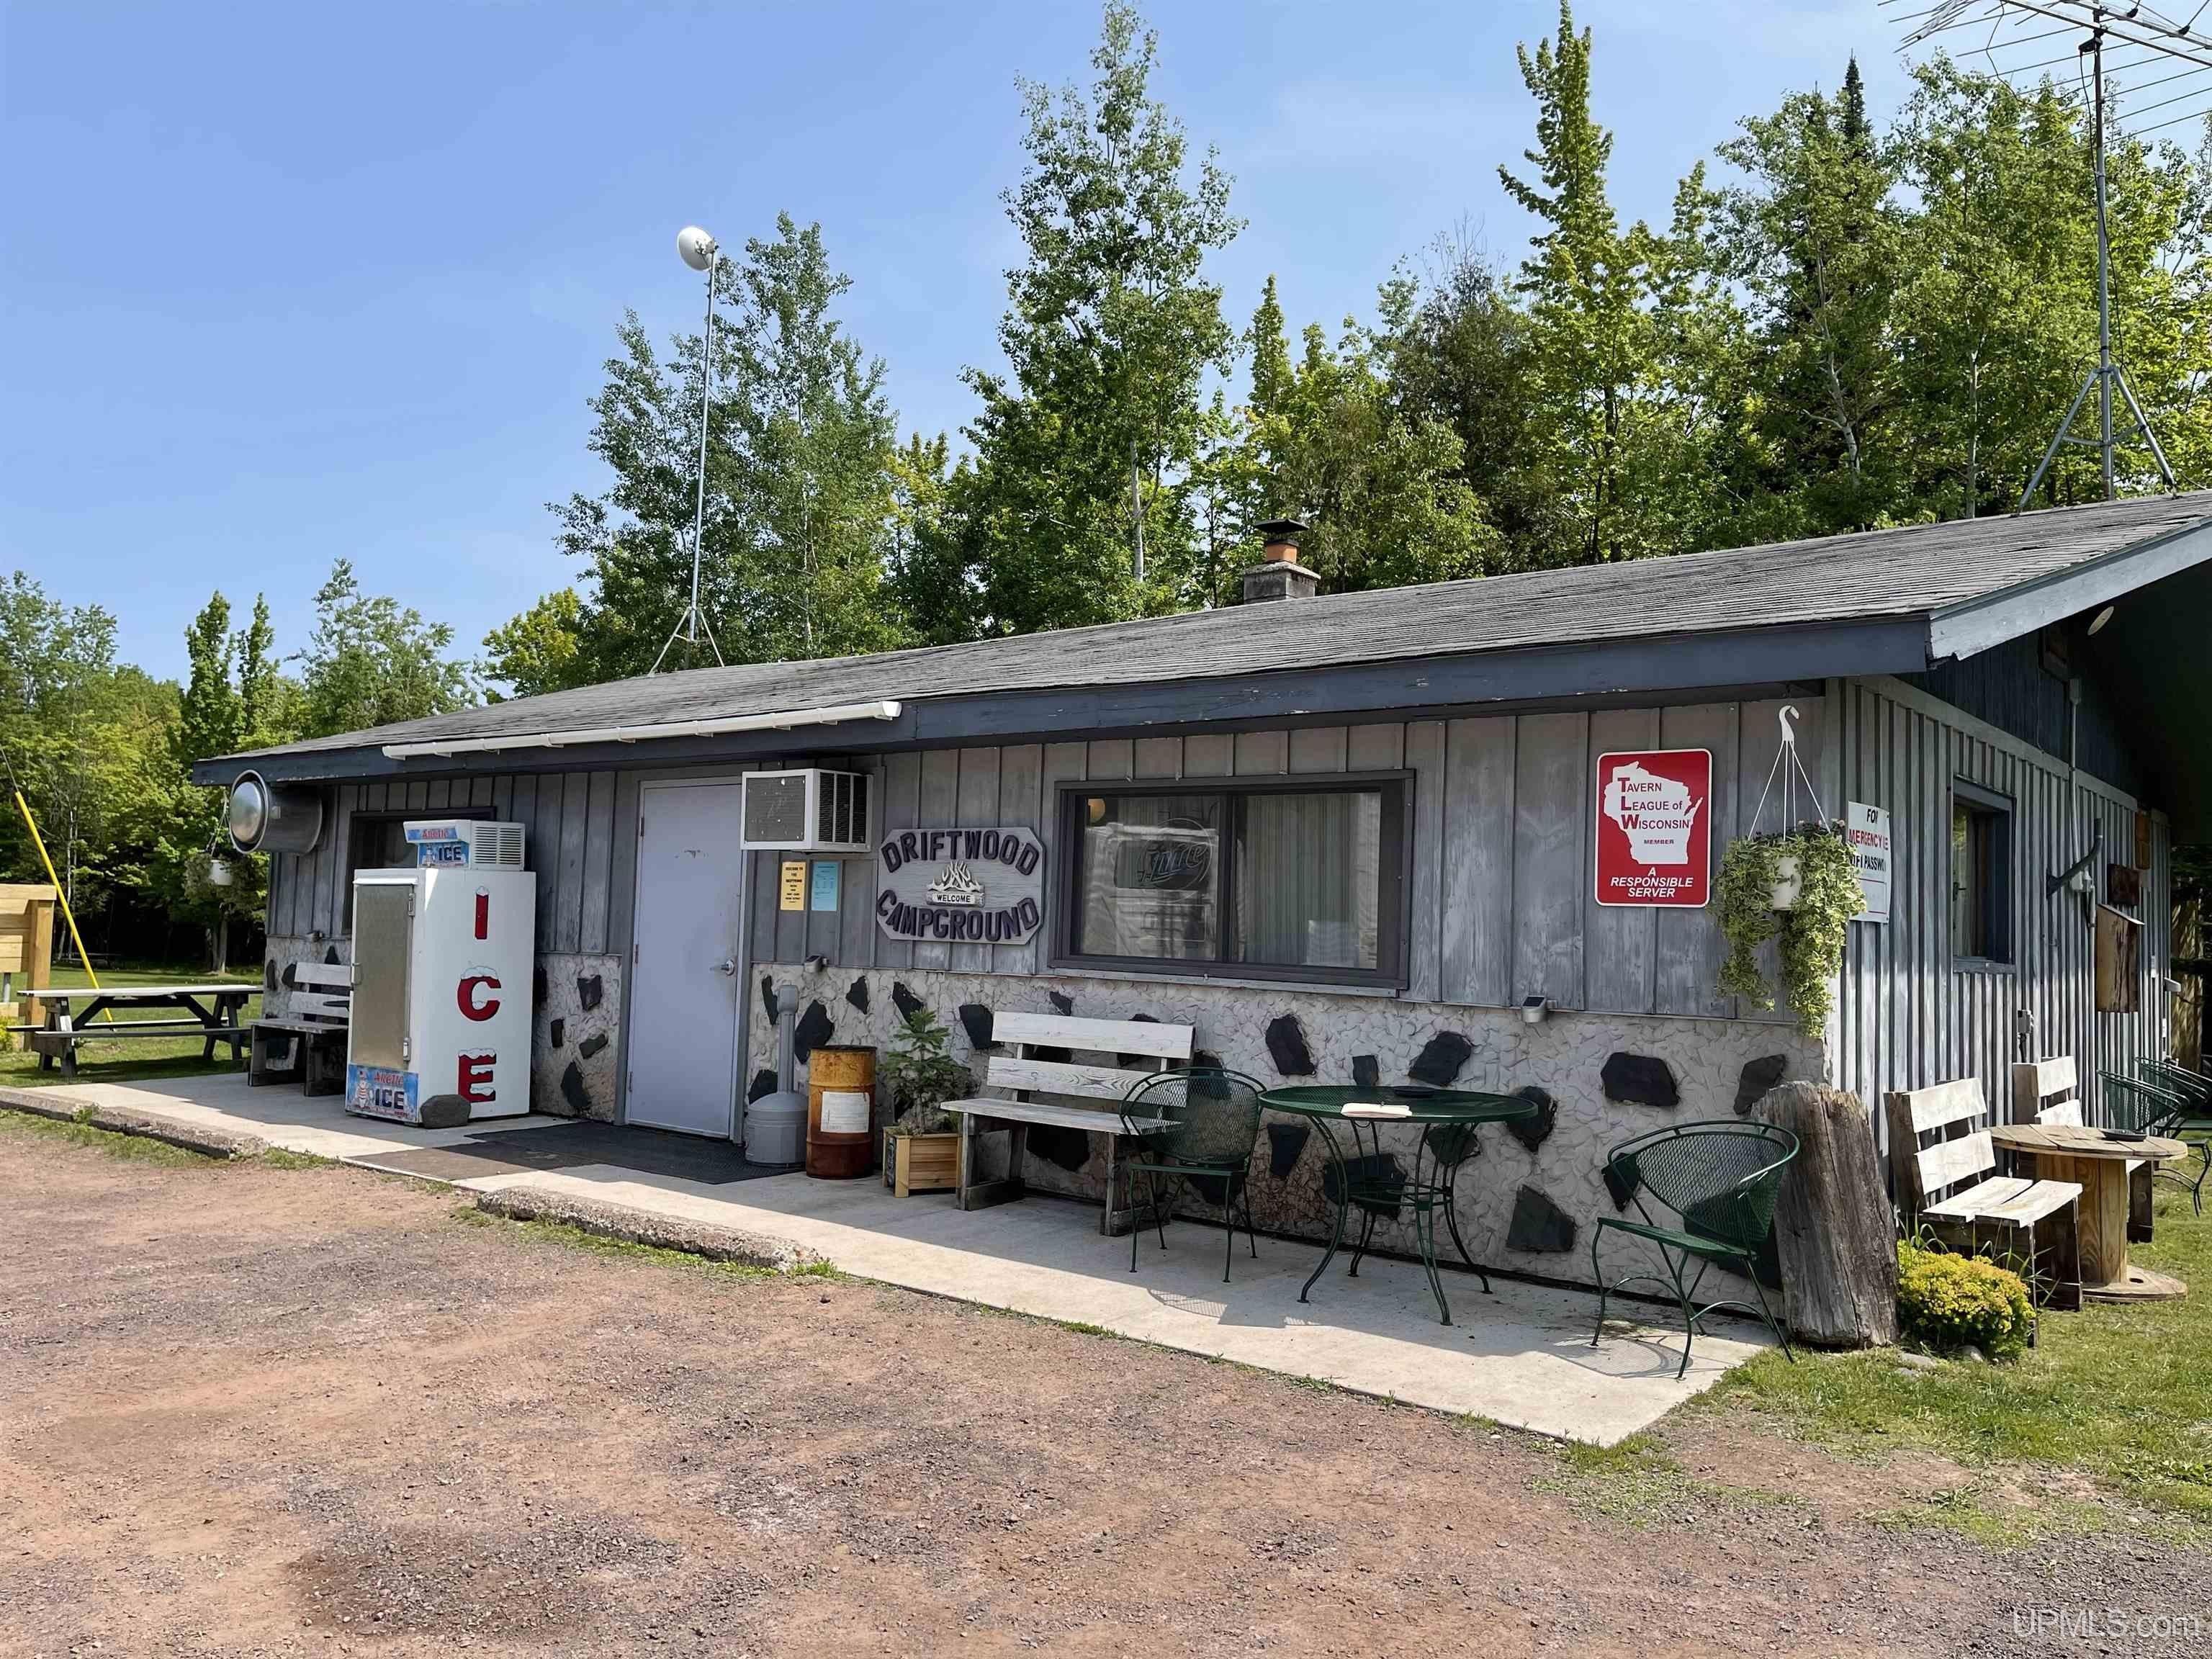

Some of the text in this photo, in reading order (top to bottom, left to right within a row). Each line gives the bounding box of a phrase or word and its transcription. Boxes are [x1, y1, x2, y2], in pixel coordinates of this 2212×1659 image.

[1617, 777, 1662, 793] TAVERN
[1621, 796, 1683, 811] LEAGUE of
[1621, 814, 1689, 830] WISCONSIN
[1849, 829, 1882, 848] MERGENCY
[439, 846, 462, 861] ICE
[881, 830, 1040, 876] DRIFTWOOD
[1647, 867, 1657, 876] A
[1611, 877, 1694, 887] RESPONSIBLE
[937, 894, 971, 903] WELCOME
[1627, 887, 1676, 898] SERVER
[877, 889, 1040, 942] CAMPGROUND
[457, 886, 502, 1103] ICE
[375, 1088, 405, 1110] ICE
